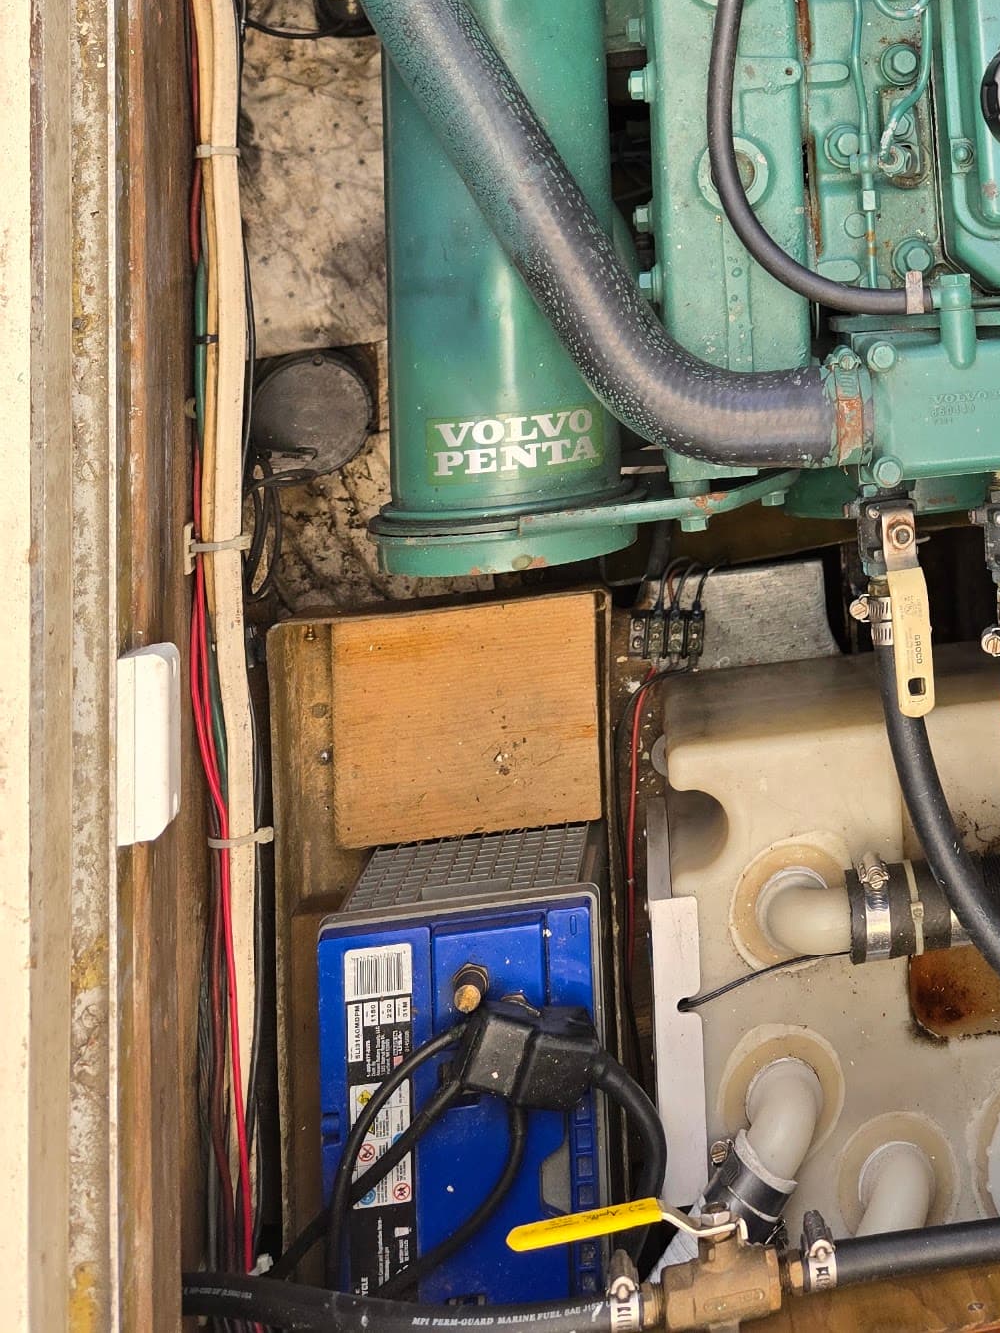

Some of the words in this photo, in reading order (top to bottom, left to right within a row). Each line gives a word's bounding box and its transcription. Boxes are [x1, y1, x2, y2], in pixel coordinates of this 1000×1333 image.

[434, 409, 593, 447] VOLVO
[433, 436, 599, 476] PENTA
[432, 1317, 494, 1326] PERM-GUARD
[497, 1314, 535, 1324] MARINE
[537, 1310, 562, 1321] FUEL
